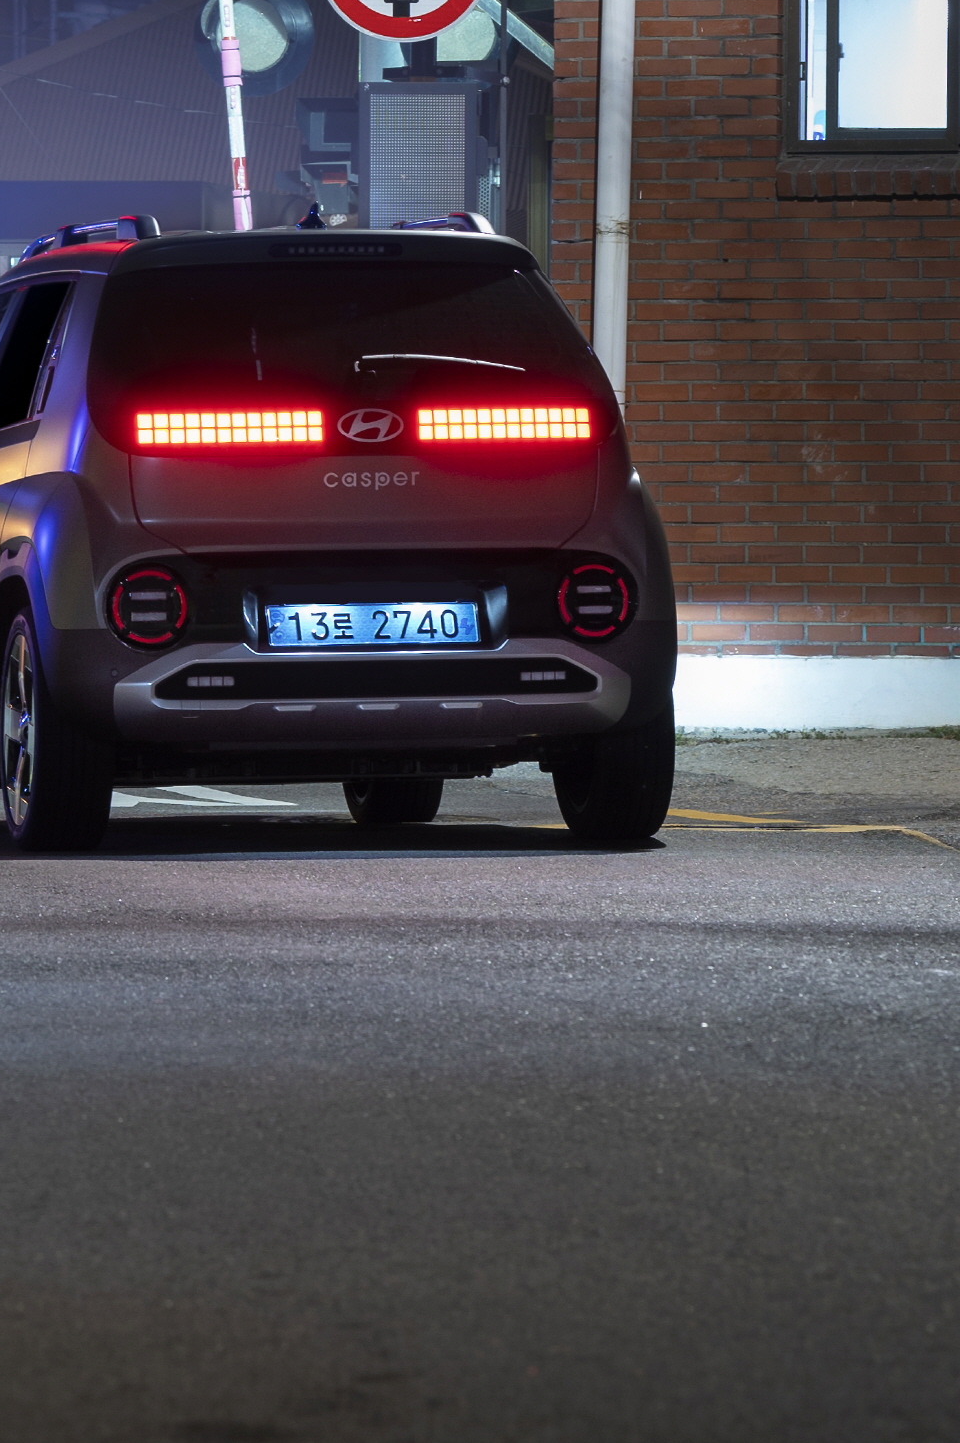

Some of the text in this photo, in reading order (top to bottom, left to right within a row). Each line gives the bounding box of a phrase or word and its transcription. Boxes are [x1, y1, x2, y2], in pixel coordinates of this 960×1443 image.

[323, 471, 420, 491] casper
[288, 609, 459, 641] 13로 2740
